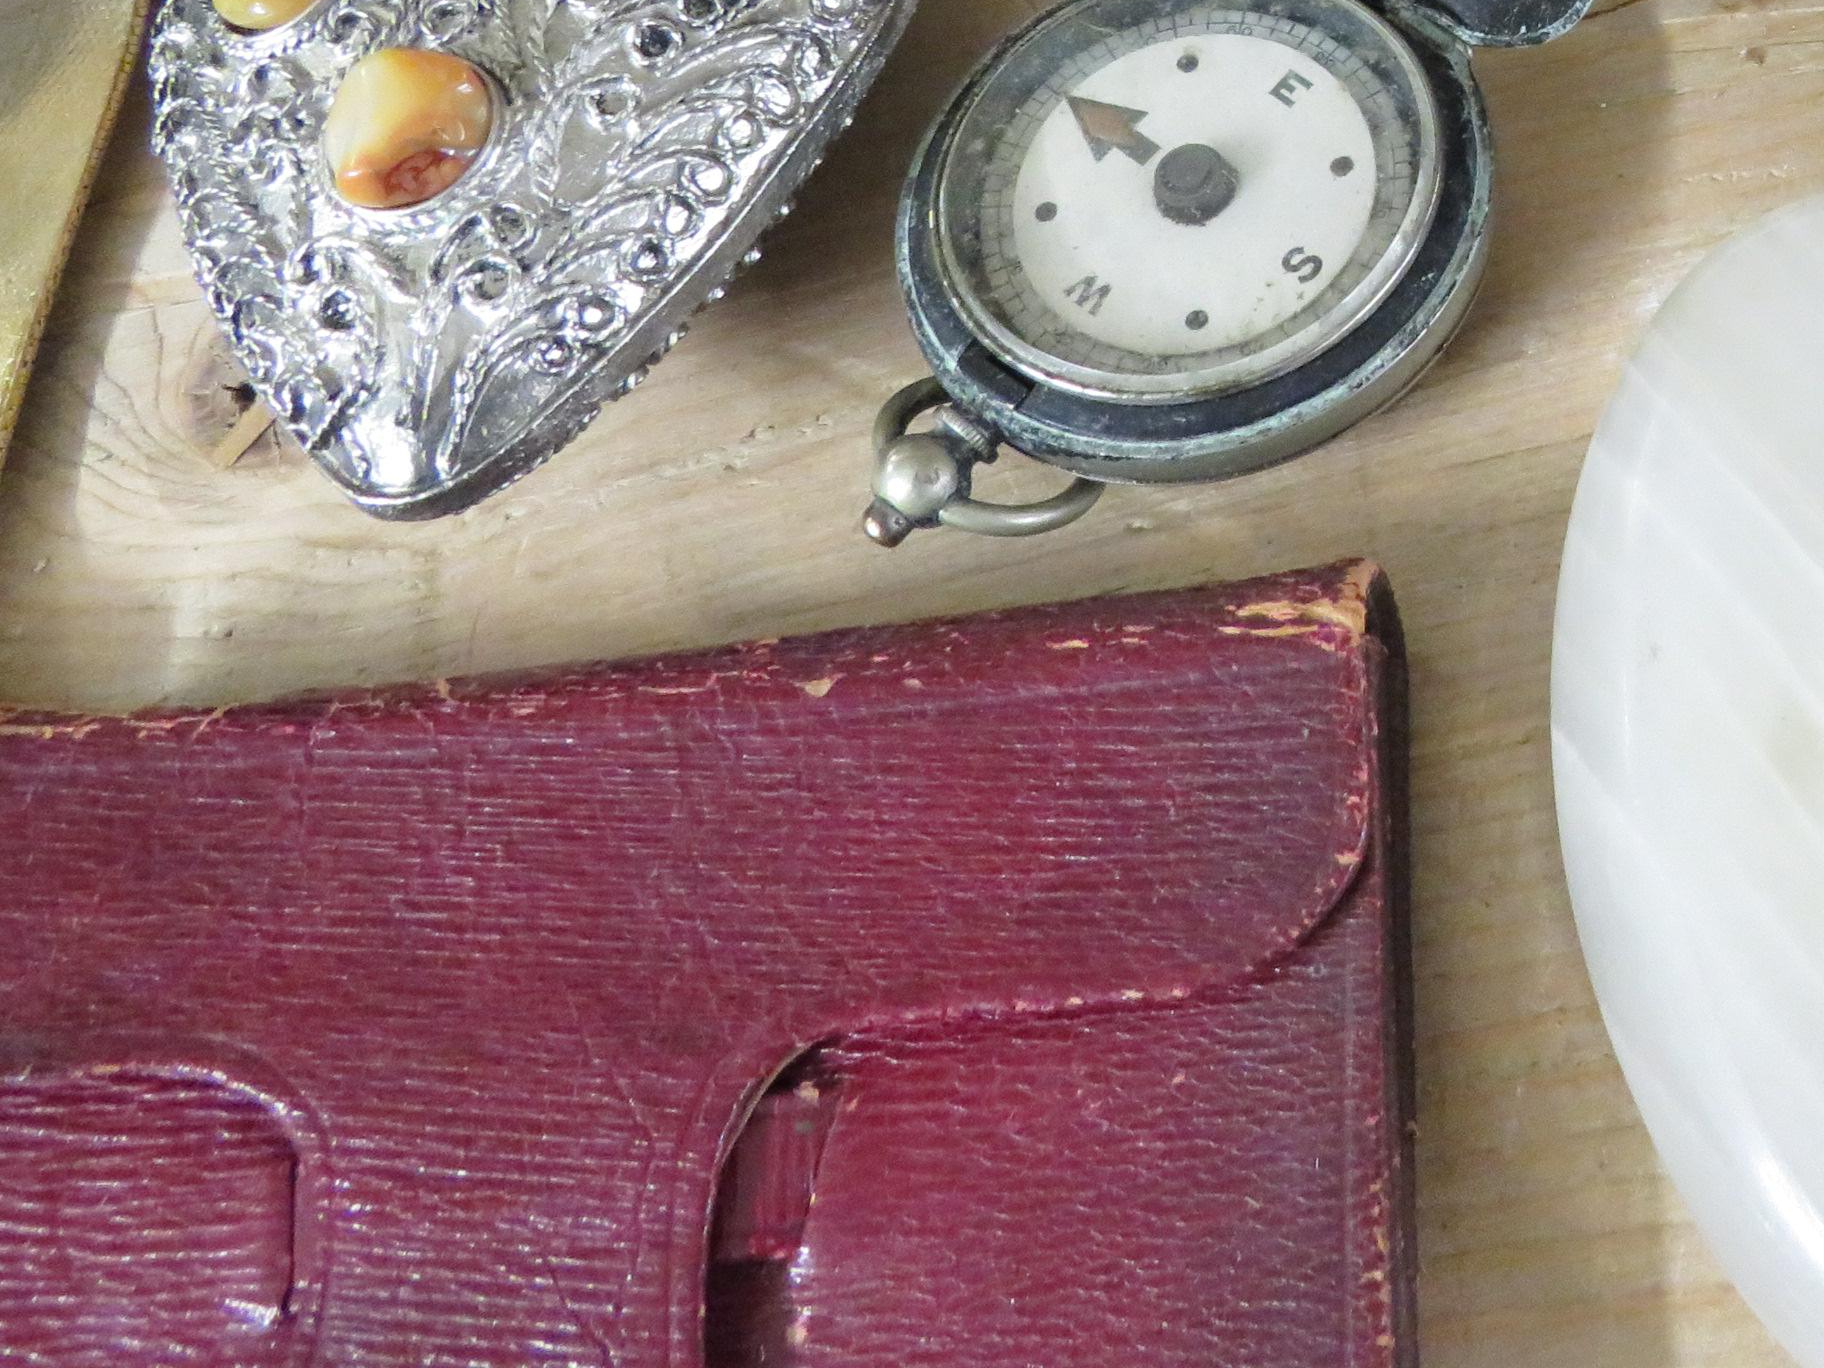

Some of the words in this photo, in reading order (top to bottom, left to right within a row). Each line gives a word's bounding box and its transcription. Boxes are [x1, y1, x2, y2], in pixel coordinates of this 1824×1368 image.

[1268, 69, 1314, 108] E
[1281, 246, 1324, 285] S
[1064, 273, 1112, 316] W
